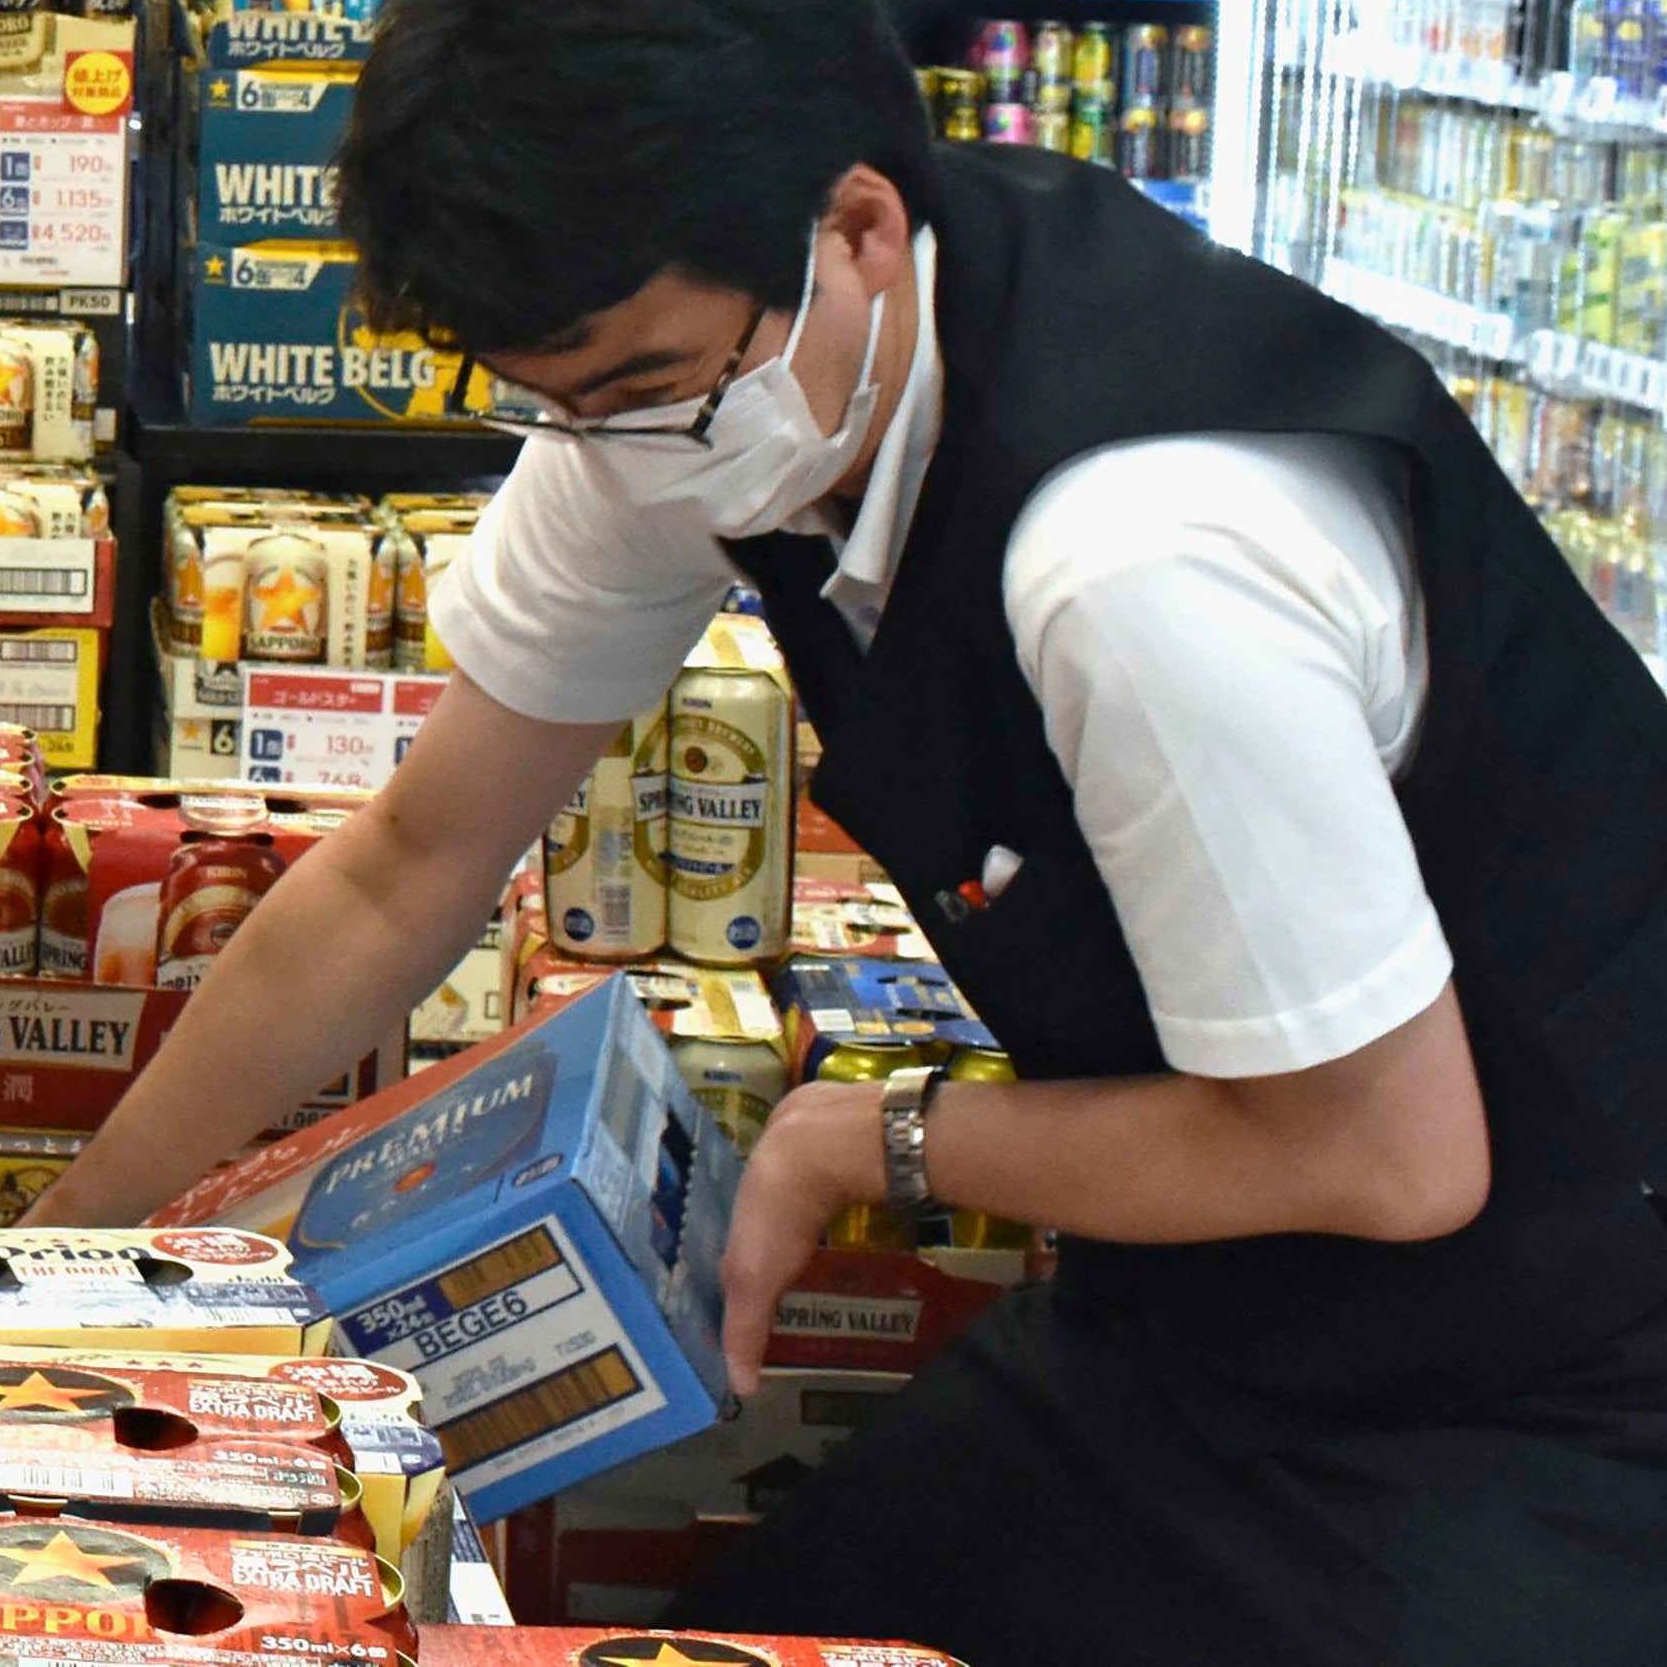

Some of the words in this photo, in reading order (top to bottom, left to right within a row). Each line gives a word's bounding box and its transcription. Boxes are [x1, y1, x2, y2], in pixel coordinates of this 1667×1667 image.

[69, 293, 111, 310] PK50
[210, 342, 334, 385] WHITE
[212, 385, 336, 404] ホワイトベルグ
[694, 796, 762, 821] VALLEY
[13, 1017, 131, 1057] VALLEY
[324, 1070, 535, 1194] PREMIUM
[413, 1290, 529, 1360] BEGE6
[774, 1303, 845, 1329] SPRING
[848, 1305, 919, 1335] VALLEY
[232, 1568, 298, 1590] EXTRA
[299, 1575, 374, 1598] DRAFT
